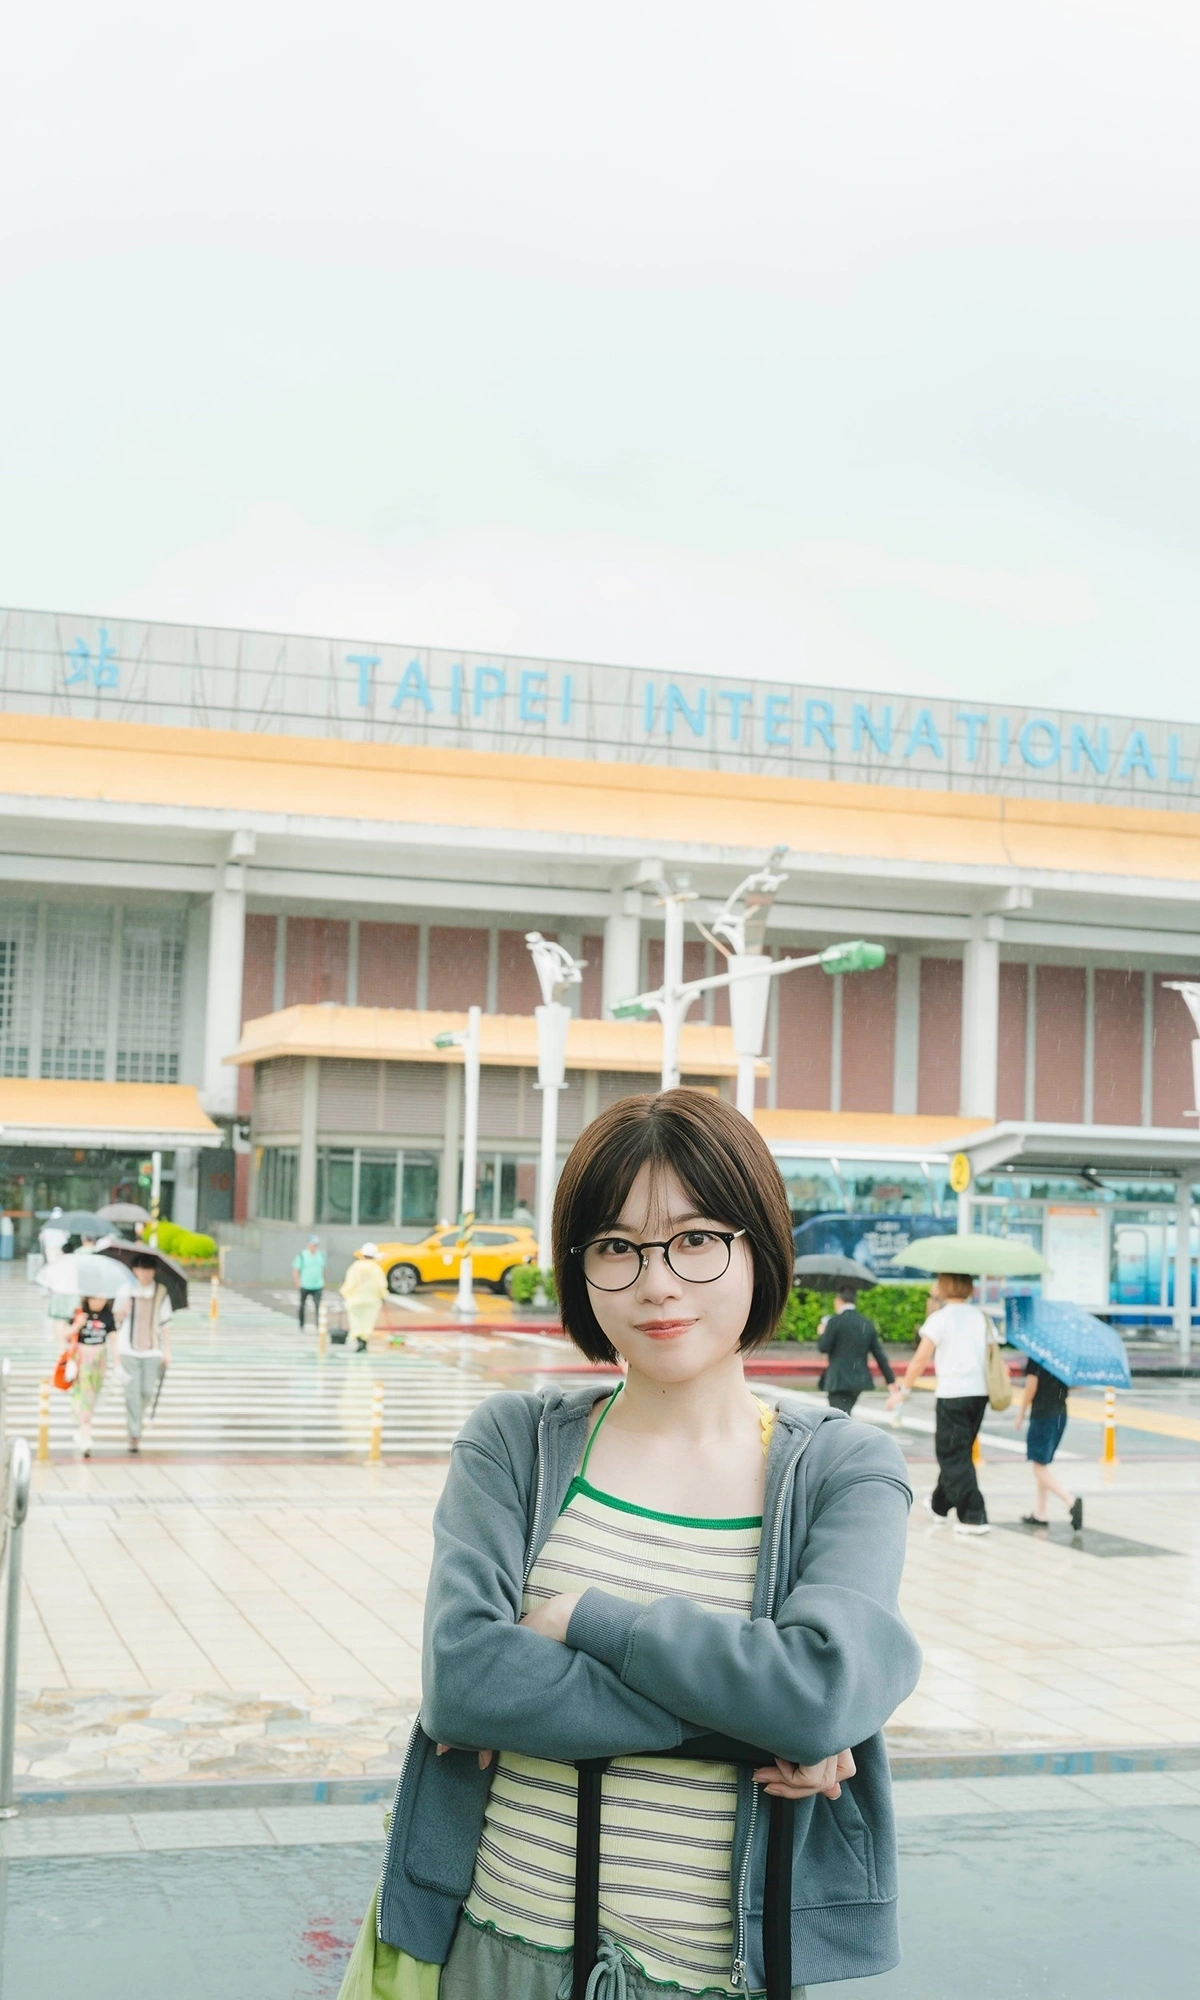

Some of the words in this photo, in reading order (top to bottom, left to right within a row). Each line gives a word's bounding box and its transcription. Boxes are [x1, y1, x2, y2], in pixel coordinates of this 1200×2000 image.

[64, 627, 120, 689] 站
[346, 654, 573, 724] TAIPEI
[643, 681, 1195, 783] INTERNATIONAL
